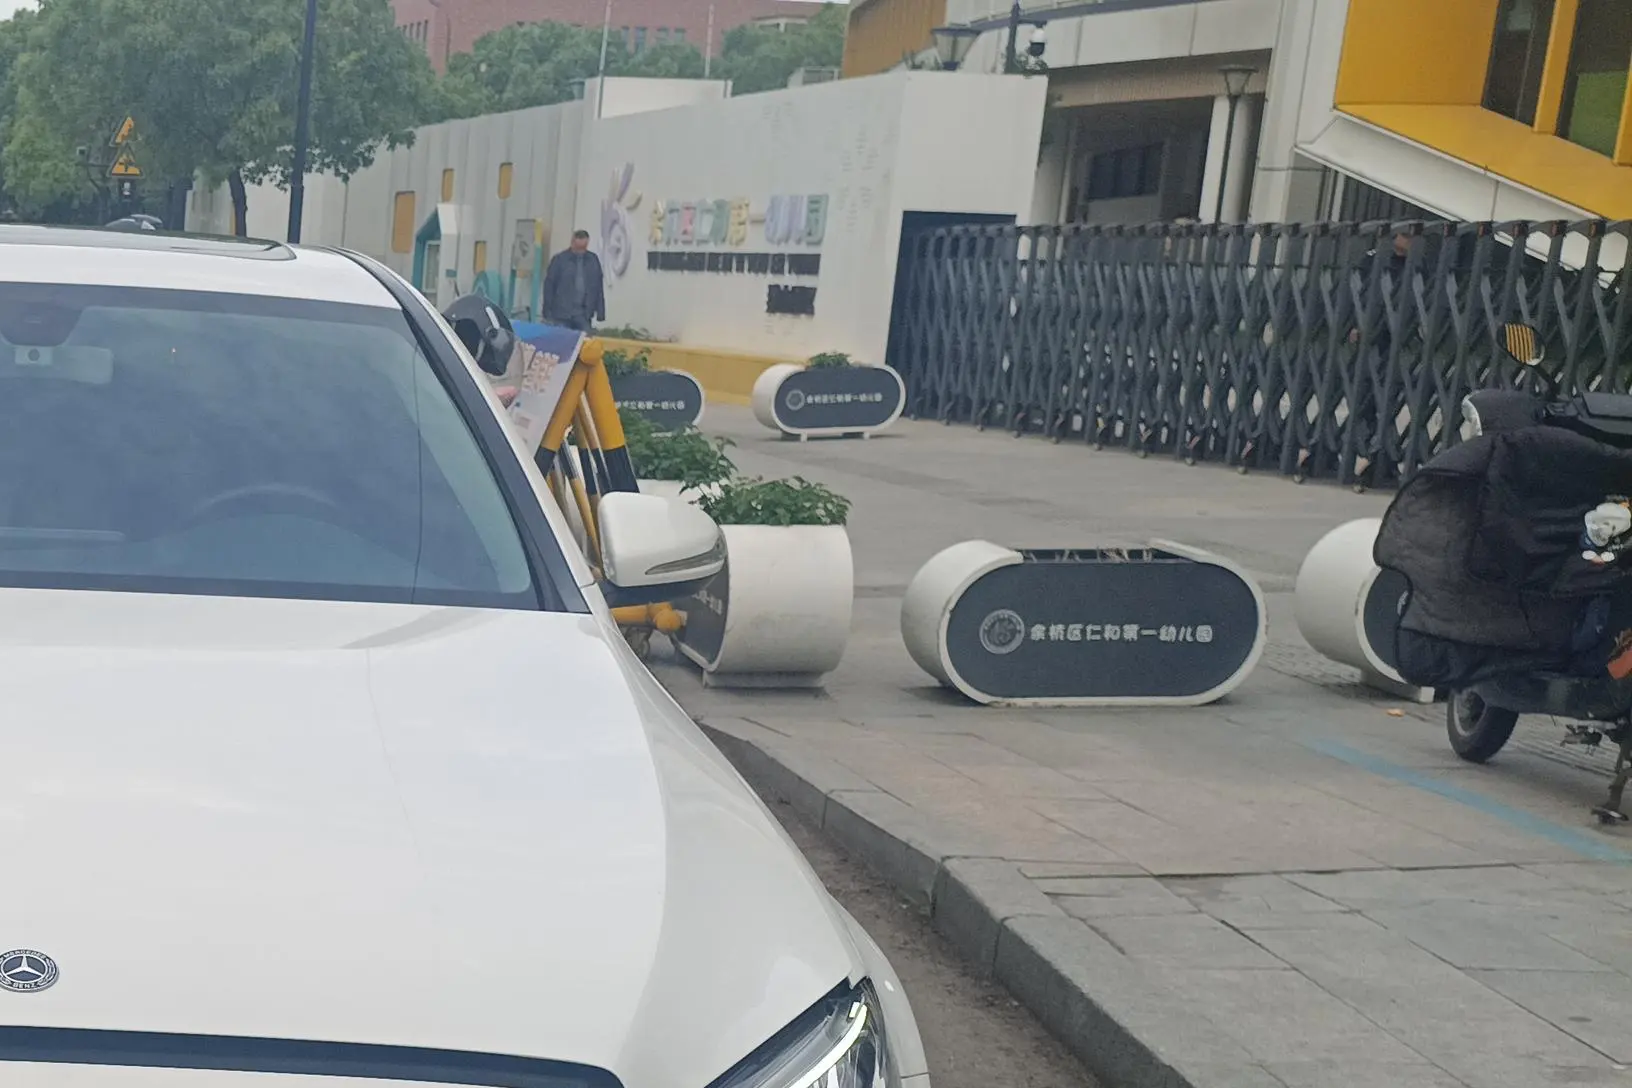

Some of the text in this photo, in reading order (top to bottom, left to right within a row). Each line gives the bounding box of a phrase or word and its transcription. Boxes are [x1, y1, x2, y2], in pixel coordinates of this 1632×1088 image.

[1030, 623, 1213, 643] 余杭区仁和第一幼儿园
